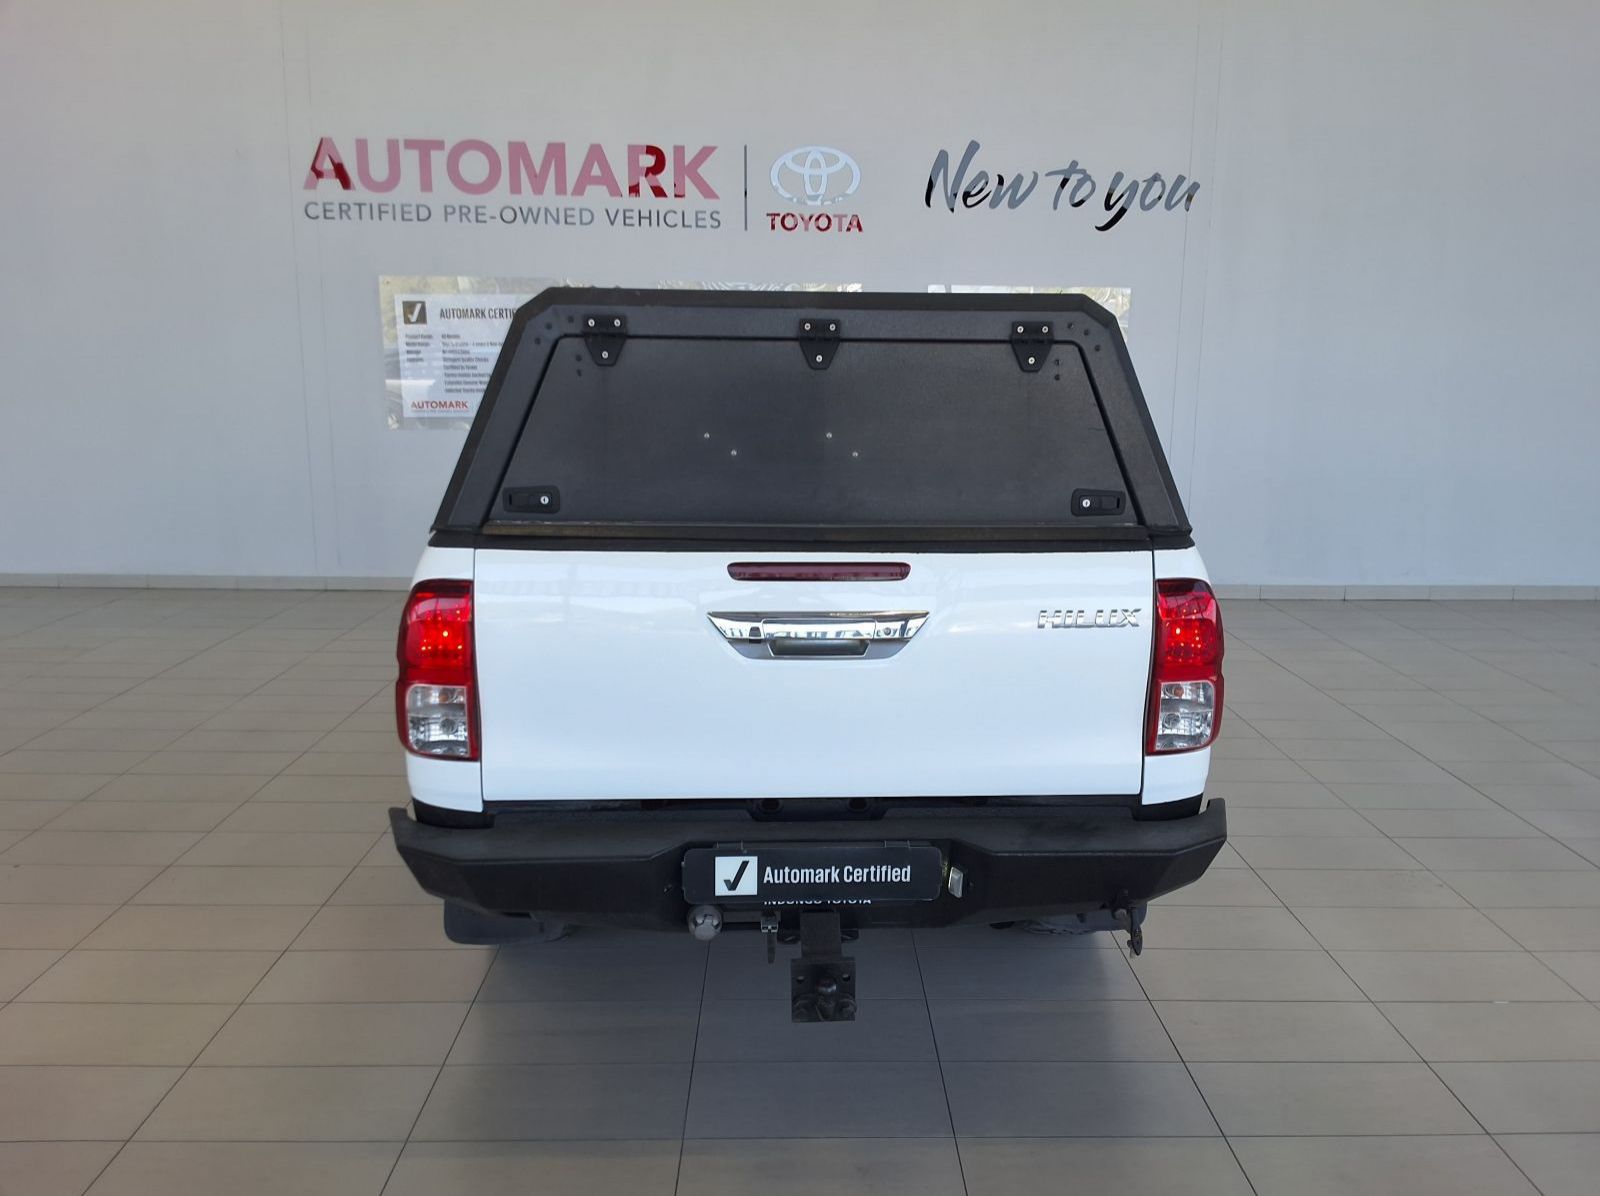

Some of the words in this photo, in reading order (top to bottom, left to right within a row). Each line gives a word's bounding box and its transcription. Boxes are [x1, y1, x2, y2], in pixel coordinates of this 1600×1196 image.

[303, 136, 721, 200] AUTOMARK
[924, 139, 1038, 213] New
[1045, 159, 1096, 211] to
[1094, 171, 1201, 232] you
[304, 201, 432, 223] CERTIFIED
[443, 204, 595, 227] PRE-OWNED
[605, 208, 722, 231] VEHICLES
[766, 212, 864, 233] TOYOTA
[439, 307, 487, 321] AUTOMARK
[411, 400, 469, 409] AUTOMARK
[1037, 608, 1142, 629] HILUX
[763, 866, 840, 885] Automark
[843, 864, 912, 884] Certified
